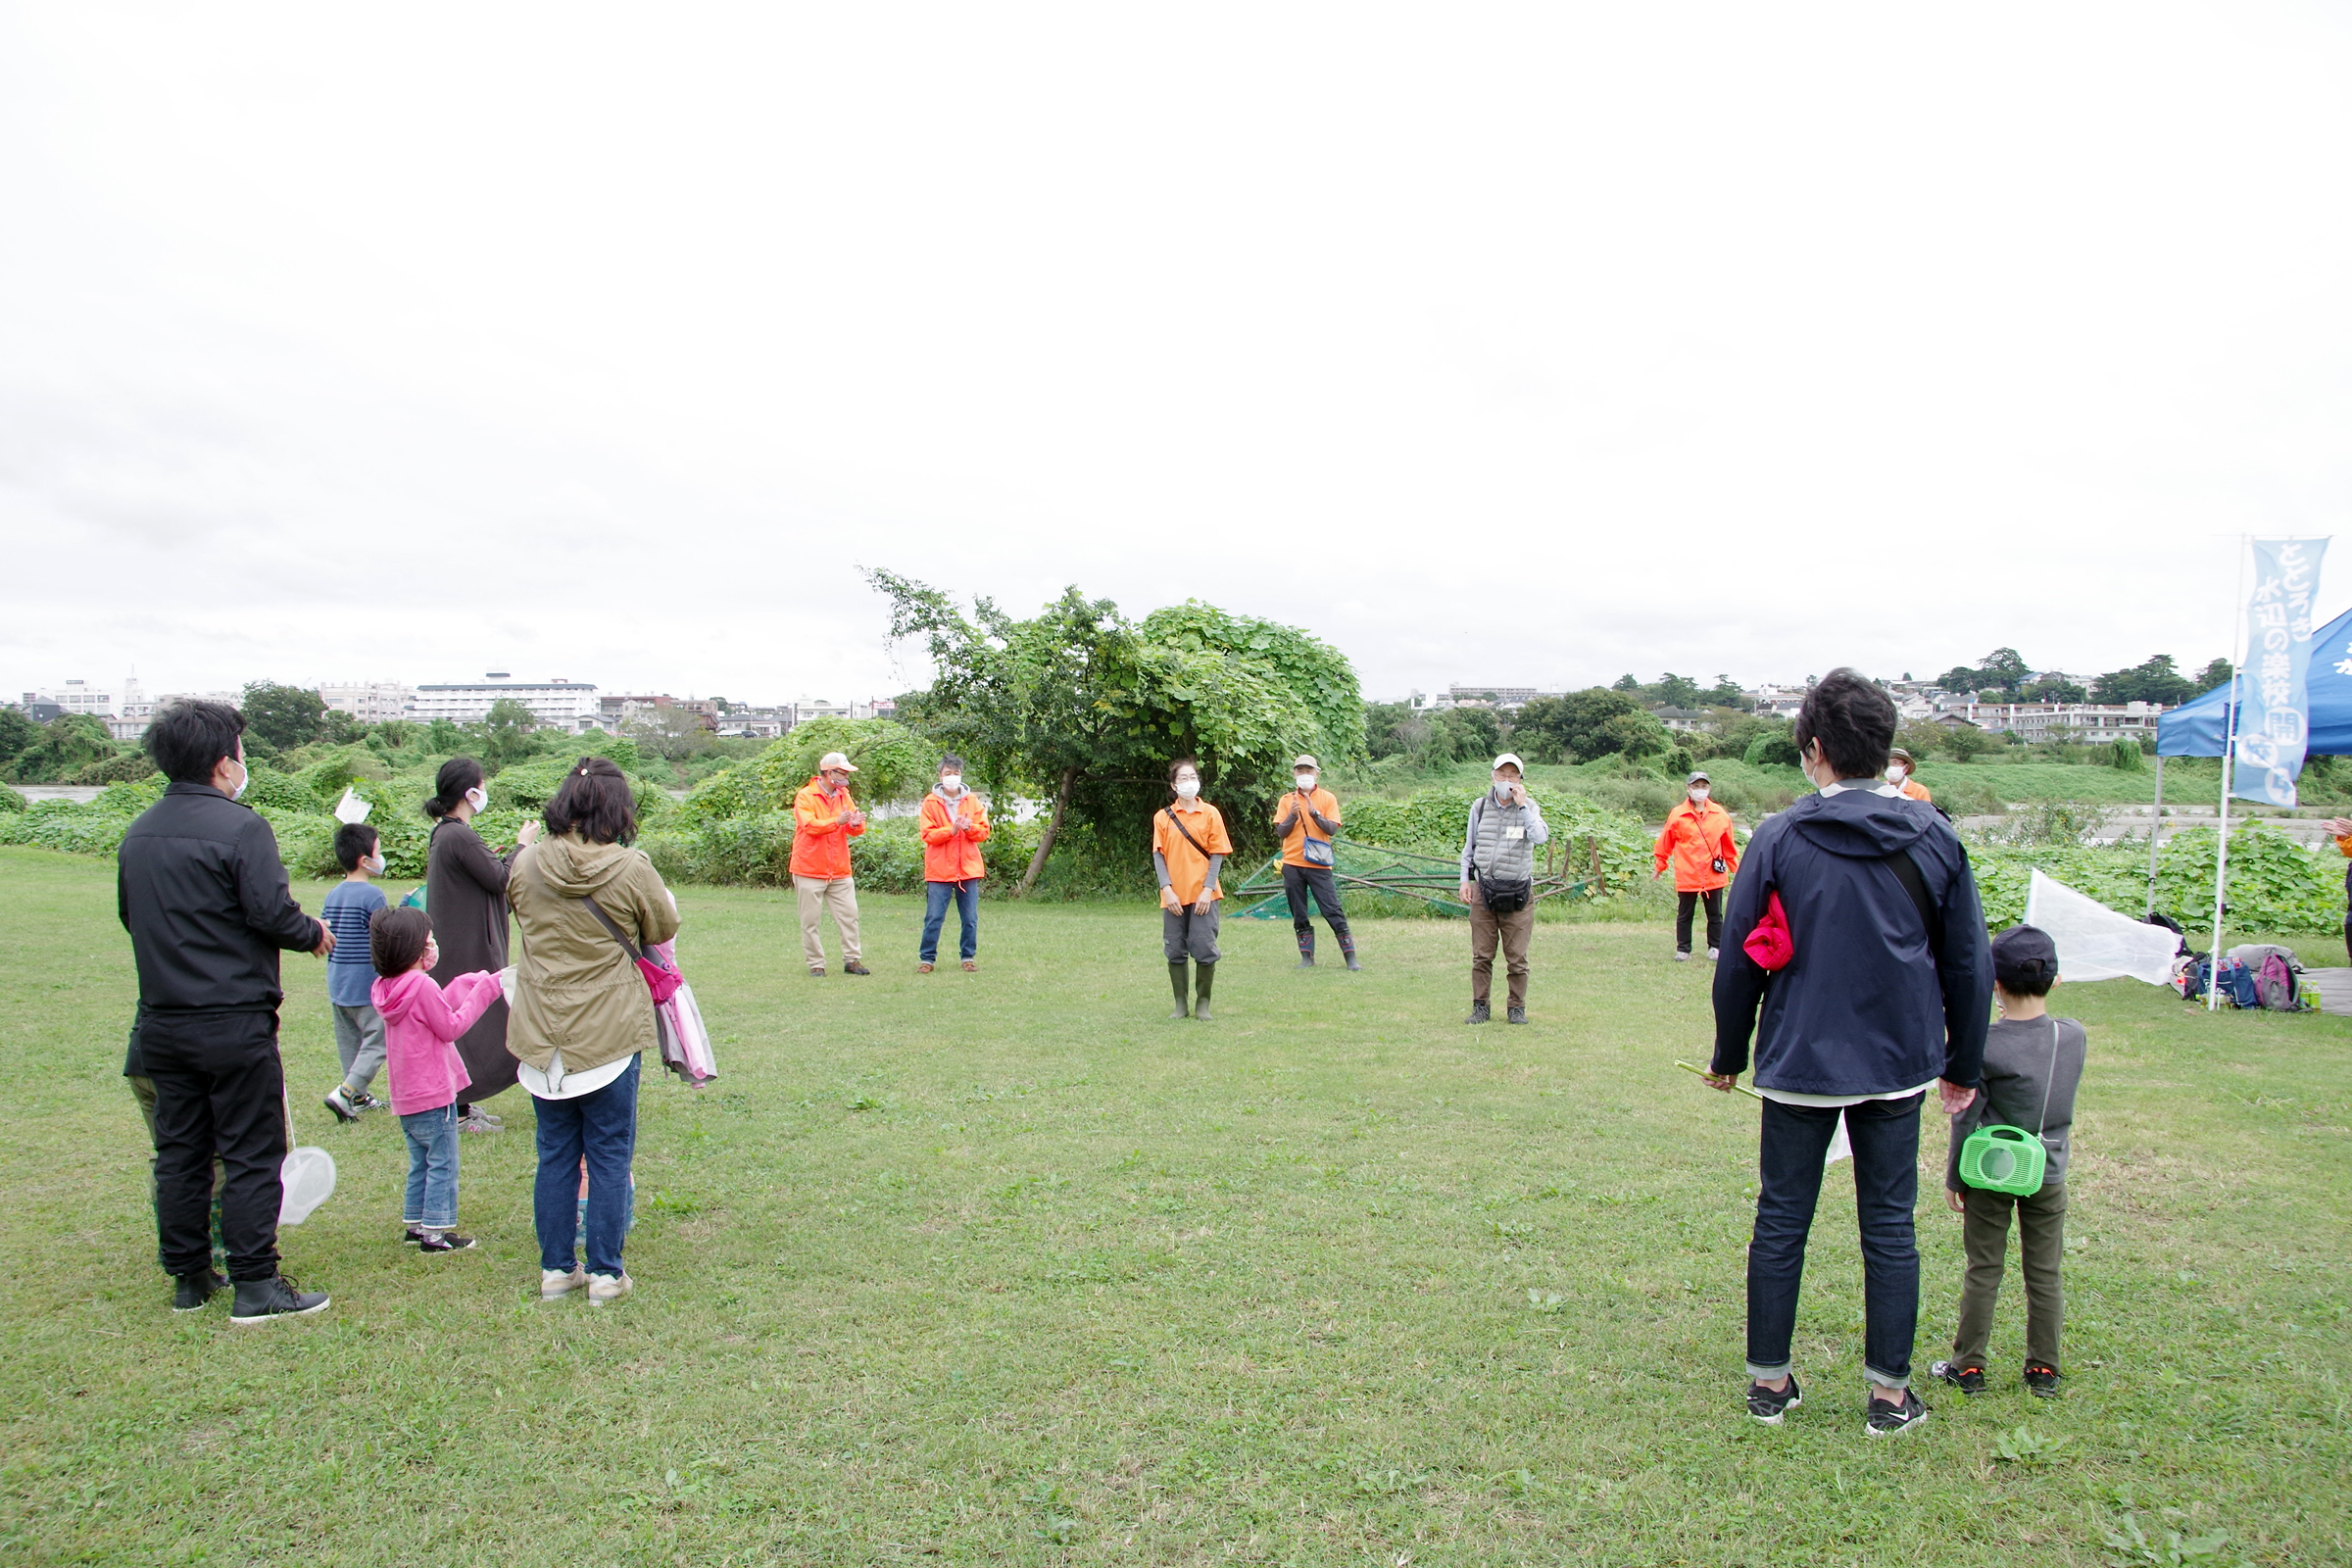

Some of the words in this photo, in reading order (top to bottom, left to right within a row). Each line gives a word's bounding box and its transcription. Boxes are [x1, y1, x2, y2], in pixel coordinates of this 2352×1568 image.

[2254, 575, 2291, 708] 水辺の楽校
